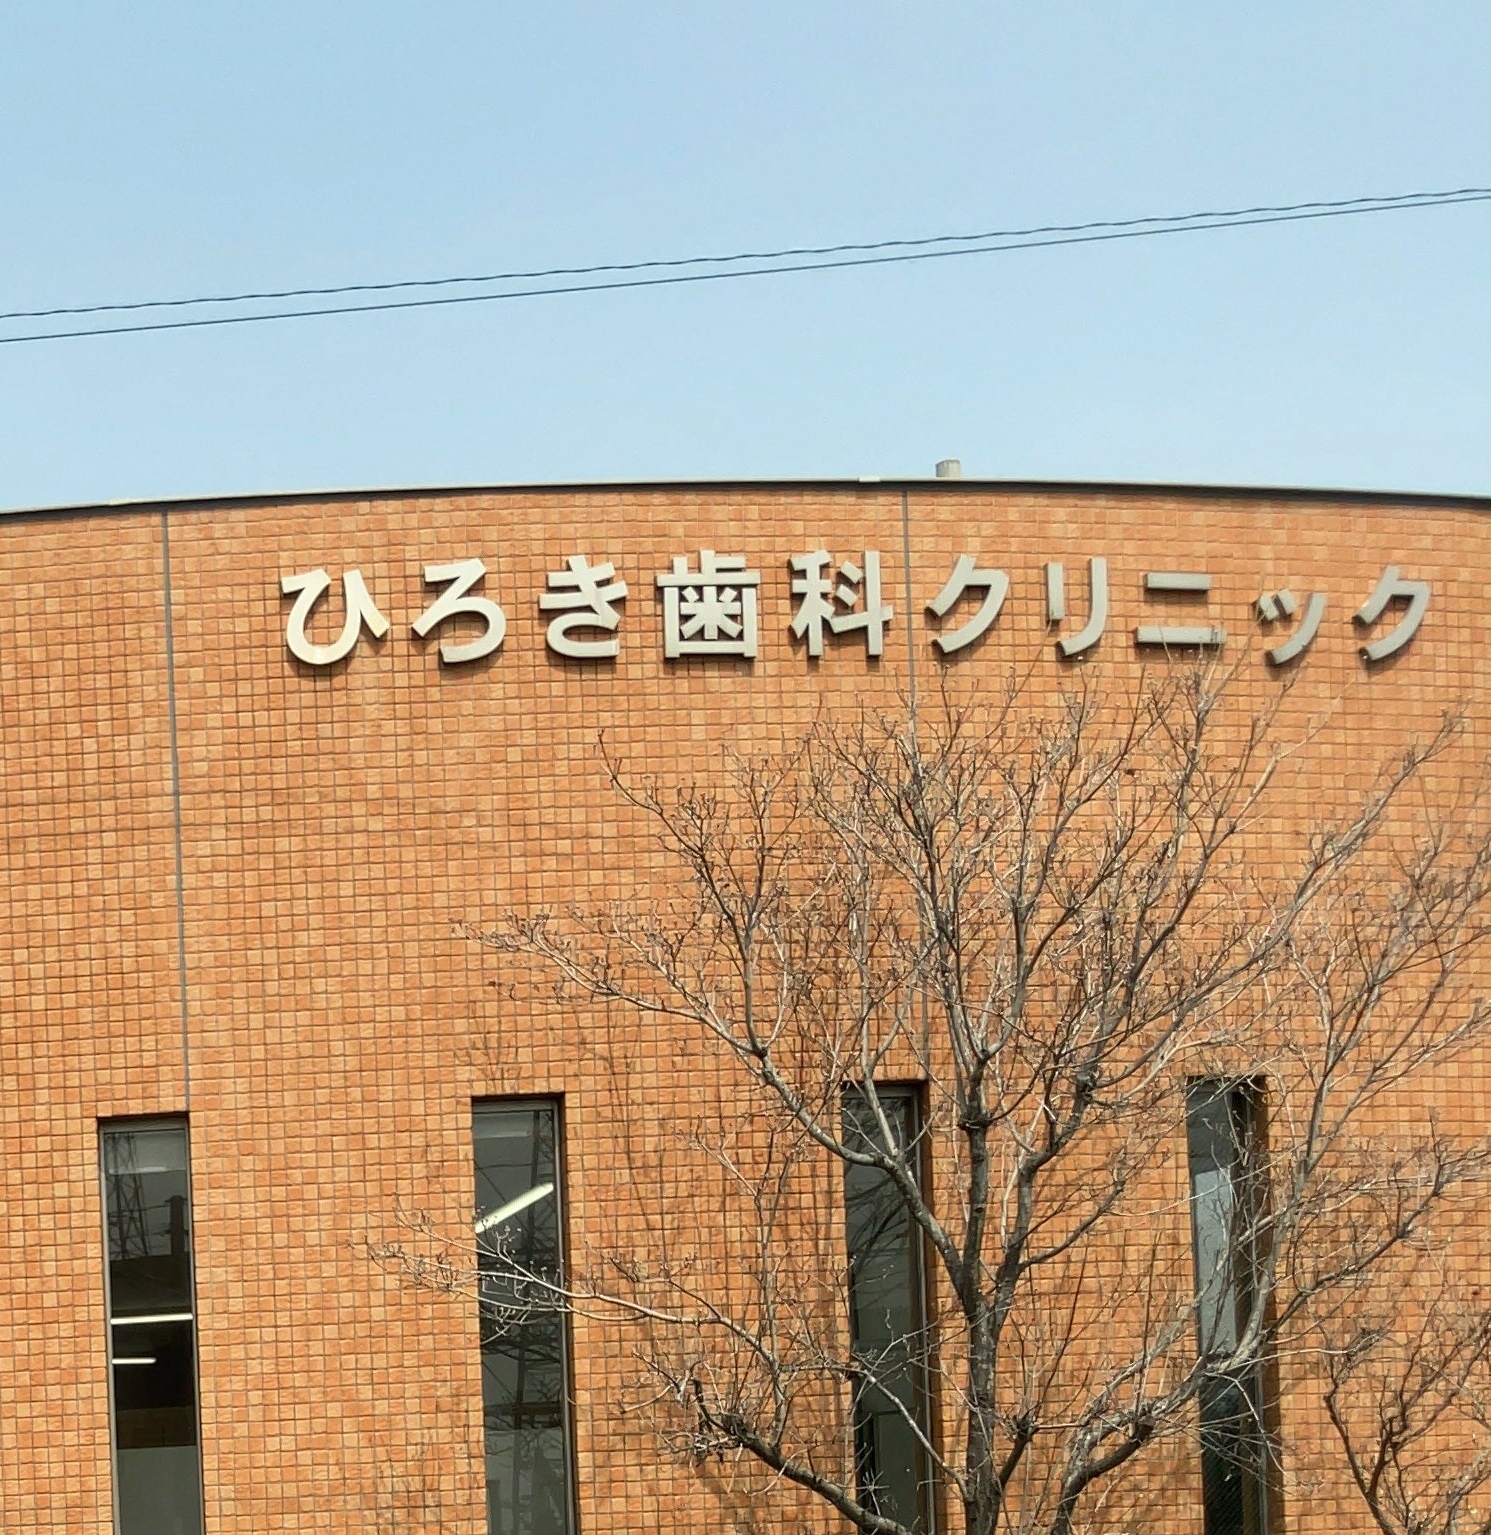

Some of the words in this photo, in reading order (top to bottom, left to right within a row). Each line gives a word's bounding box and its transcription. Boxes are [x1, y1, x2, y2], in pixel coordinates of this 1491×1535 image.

[280, 549, 1431, 665] ひろき歯科クリニック
